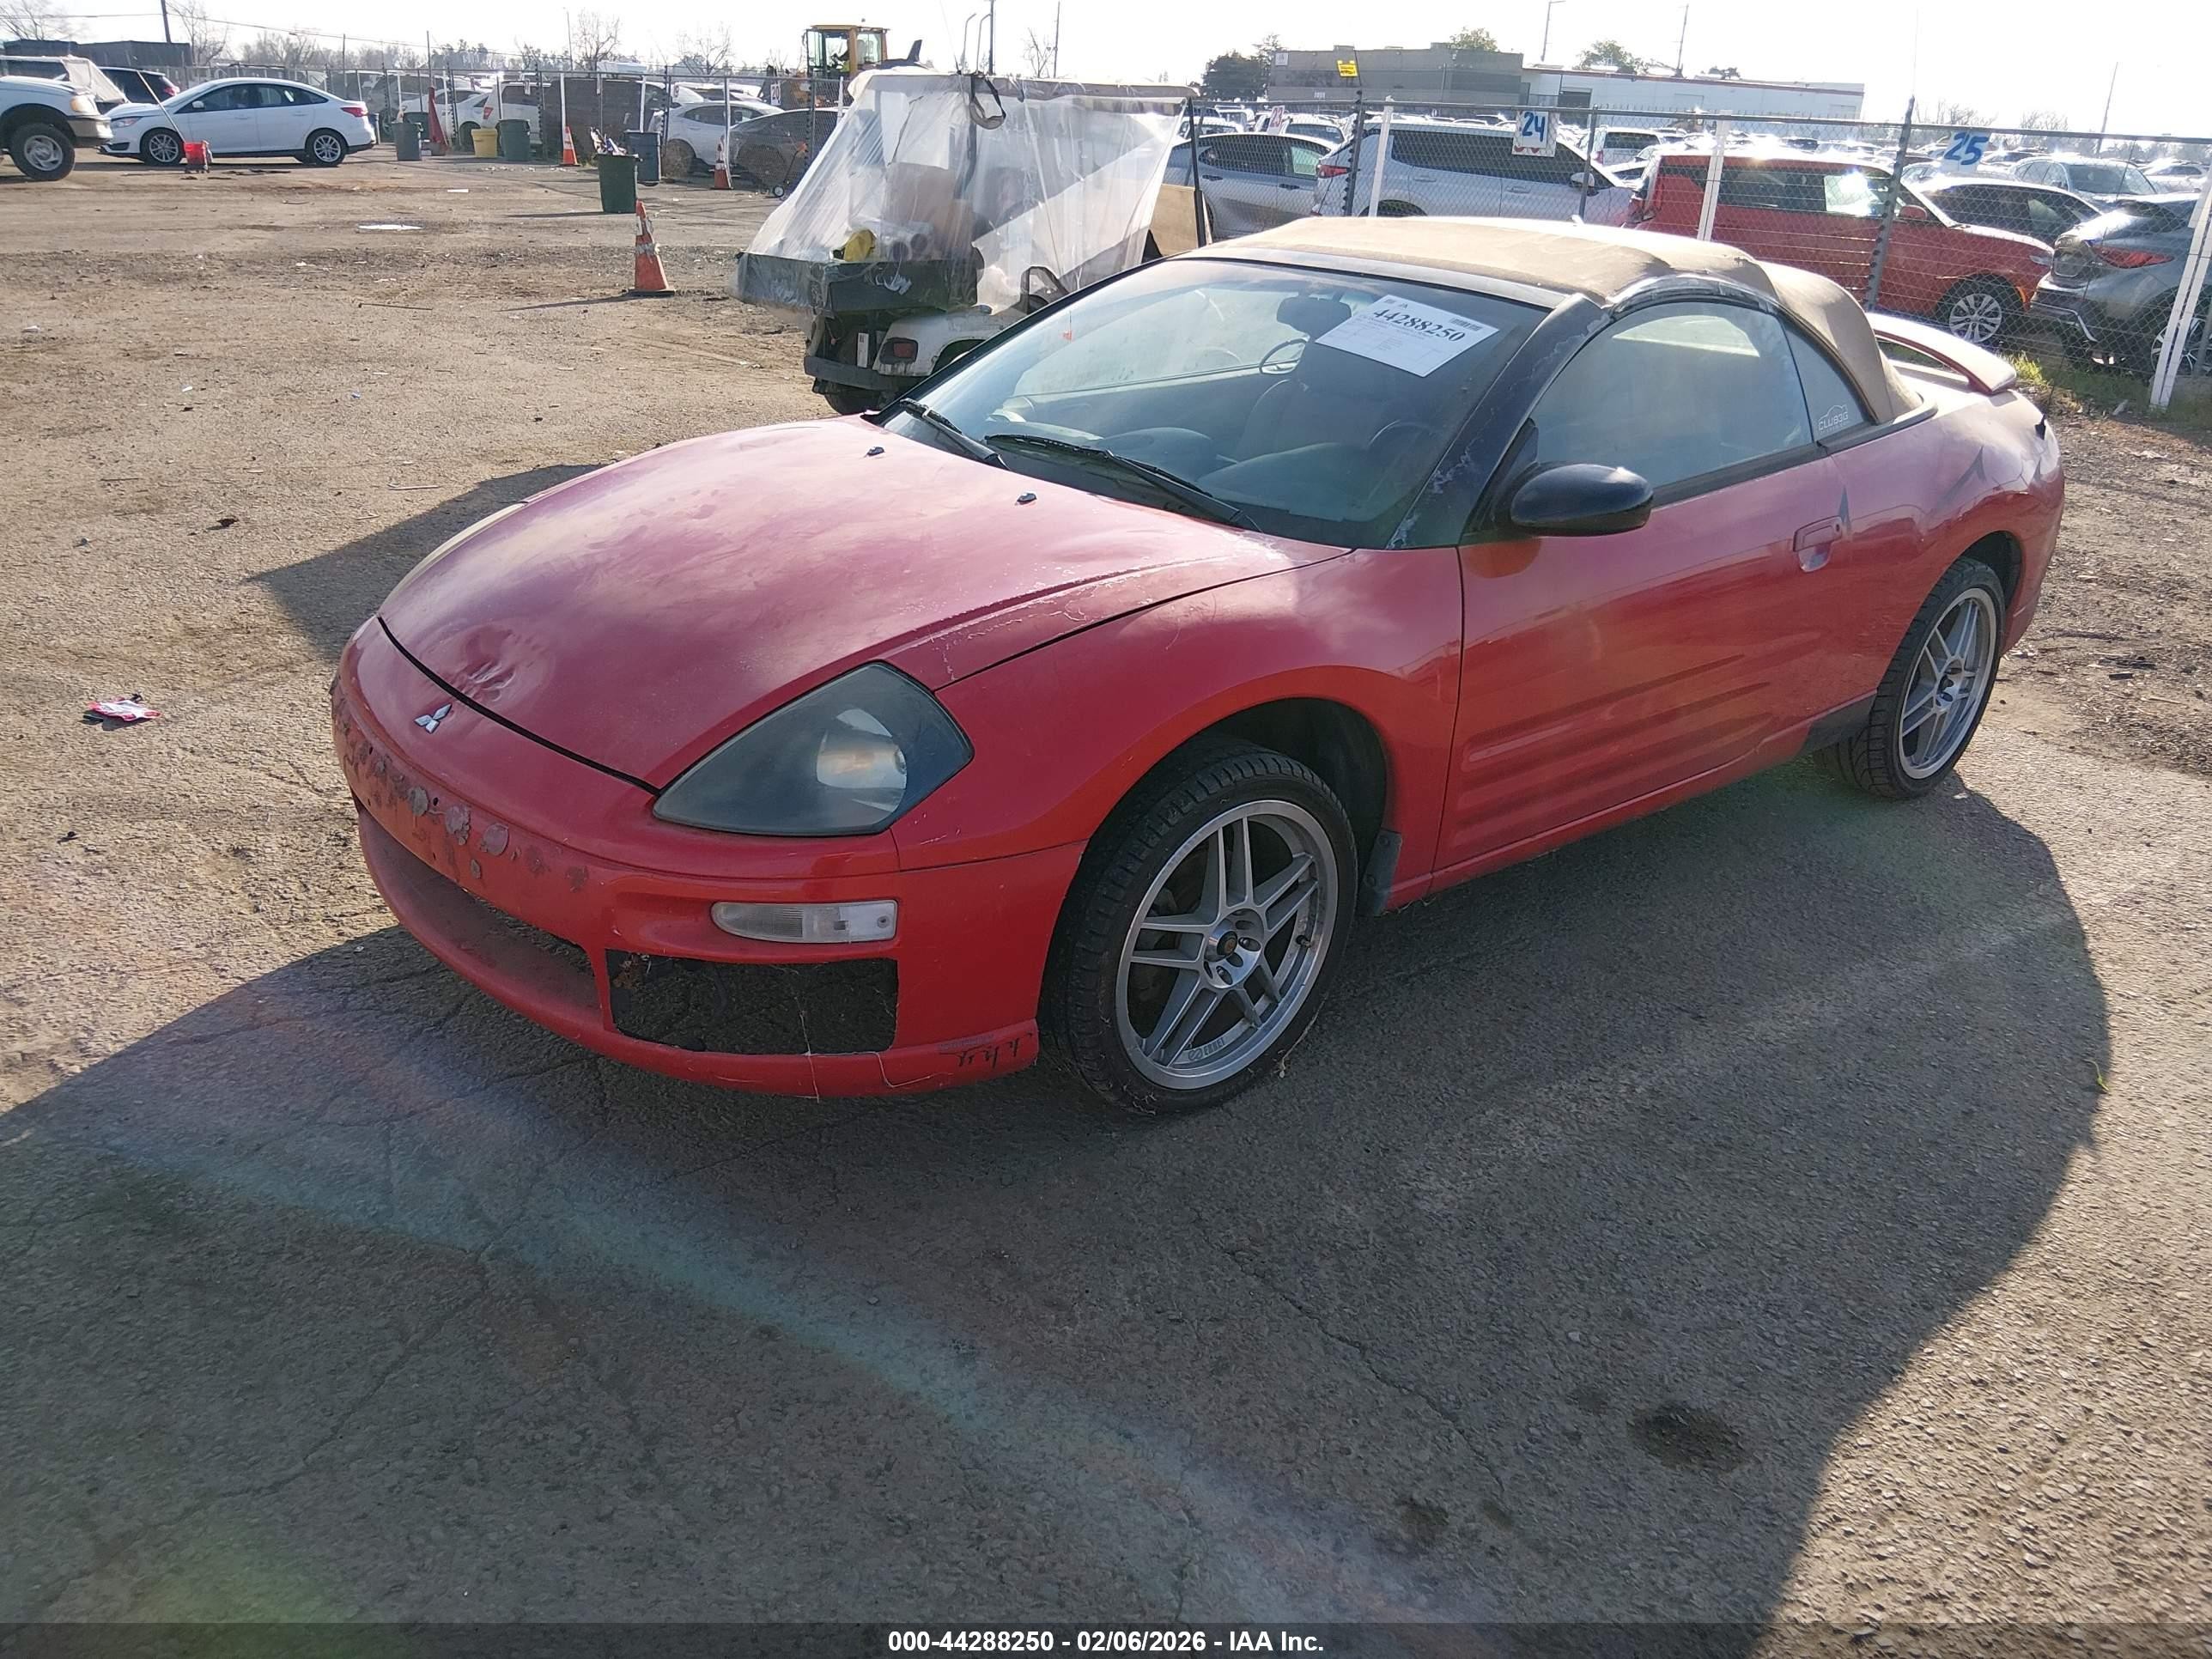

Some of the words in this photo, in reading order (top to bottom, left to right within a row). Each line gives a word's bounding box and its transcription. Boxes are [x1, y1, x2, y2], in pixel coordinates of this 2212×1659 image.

[1522, 111, 1546, 143] 24
[1943, 131, 1990, 166] 25
[1373, 308, 1467, 343] 44288250
